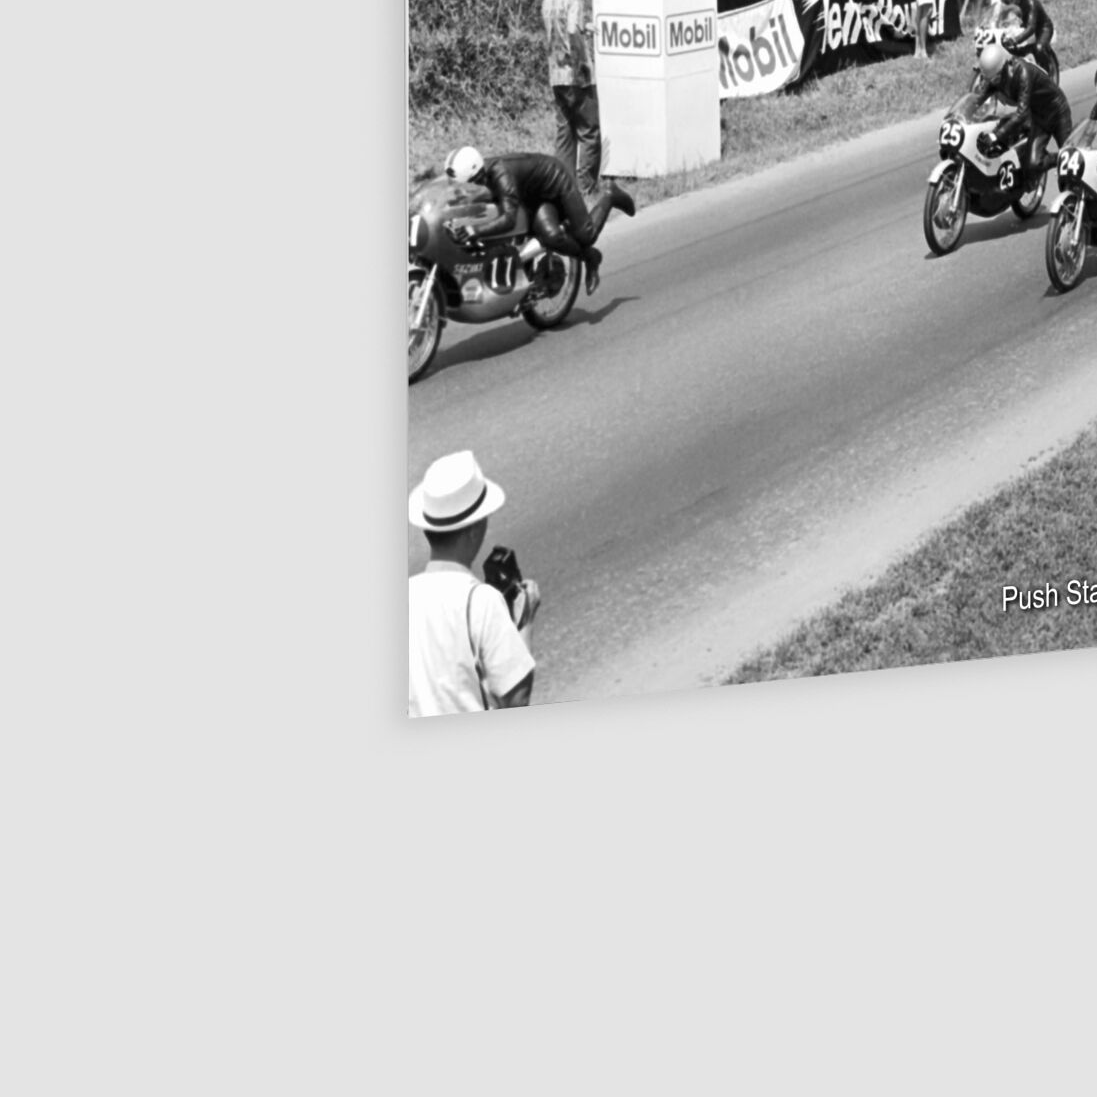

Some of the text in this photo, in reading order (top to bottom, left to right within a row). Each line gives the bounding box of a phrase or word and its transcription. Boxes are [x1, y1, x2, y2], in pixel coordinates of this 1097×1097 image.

[601, 20, 656, 49] Mobil
[669, 16, 713, 48] Mobil
[975, 29, 994, 47] 22
[941, 123, 962, 146] 25
[1060, 150, 1080, 176] 24
[1000, 164, 1014, 190] 25
[491, 257, 513, 288] 11
